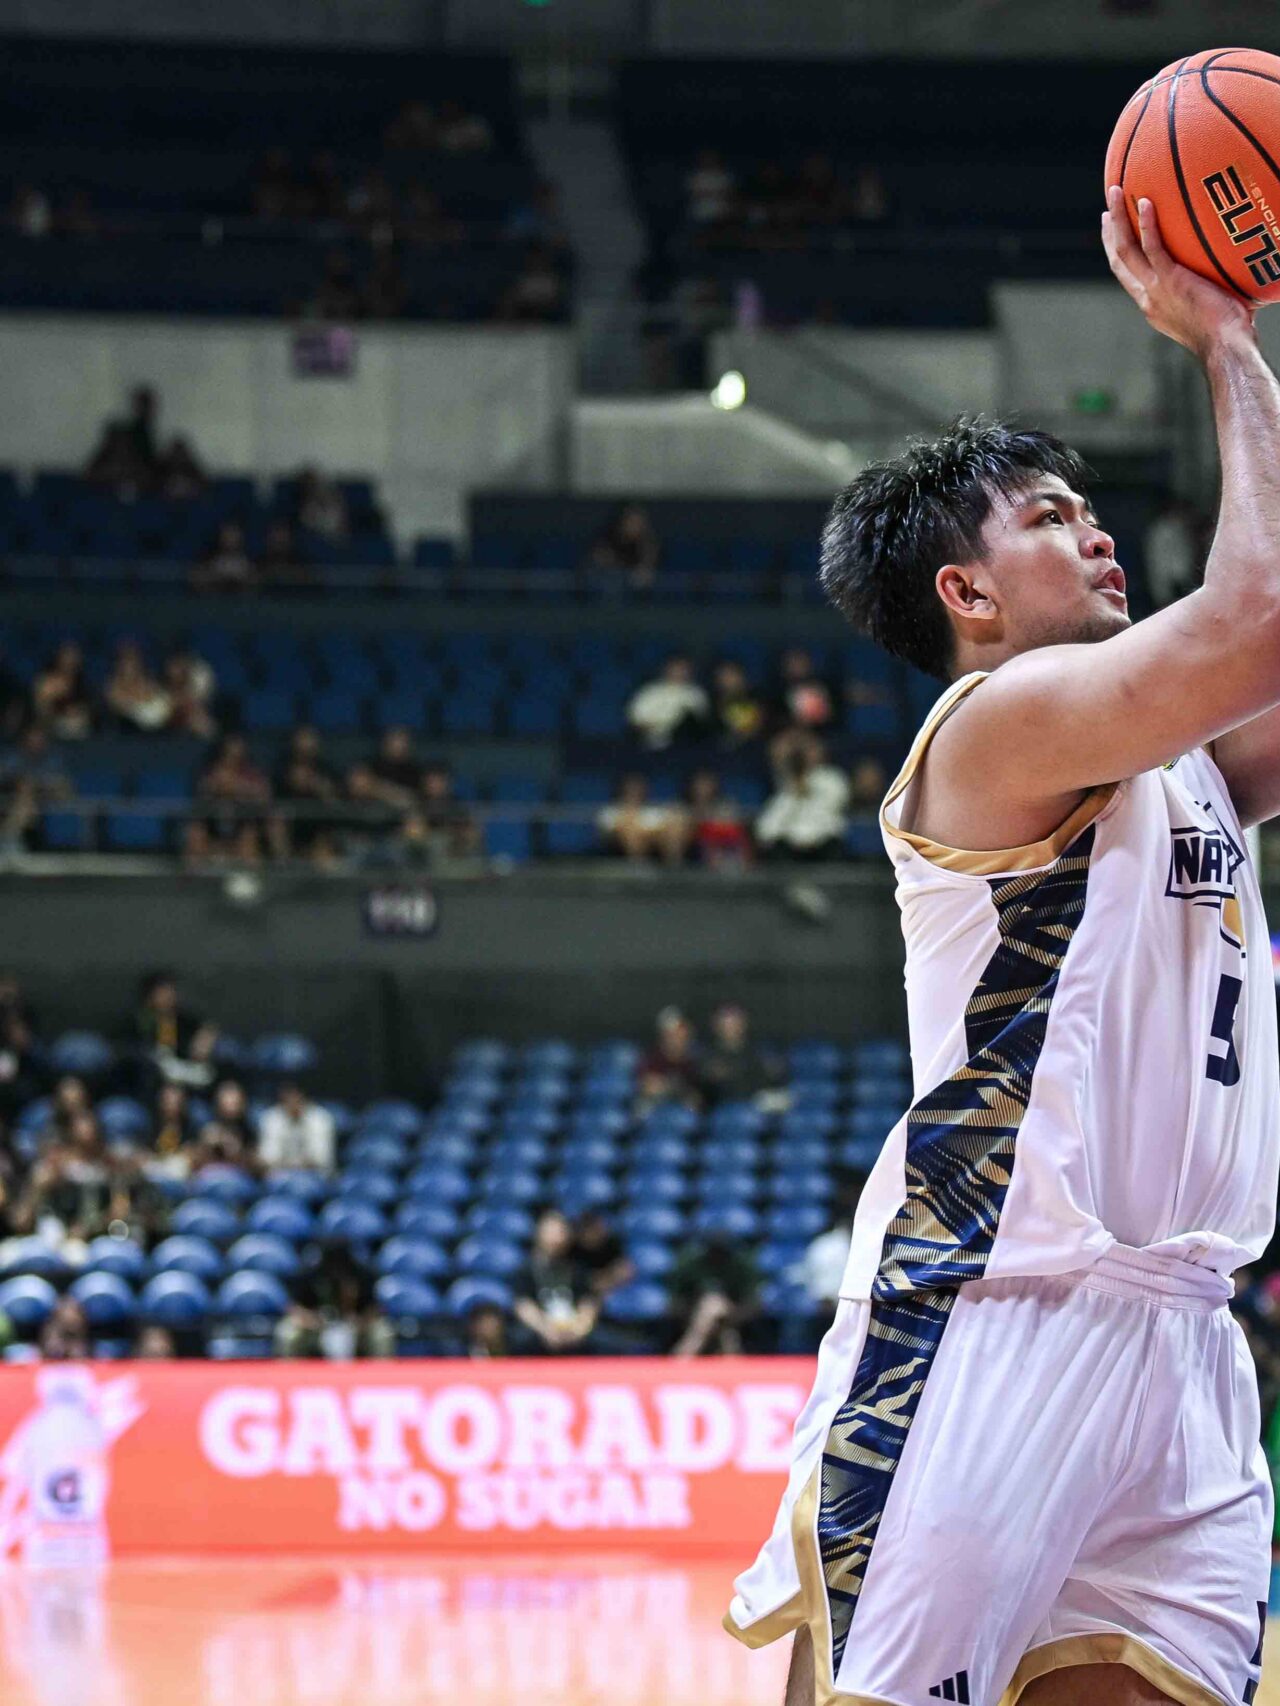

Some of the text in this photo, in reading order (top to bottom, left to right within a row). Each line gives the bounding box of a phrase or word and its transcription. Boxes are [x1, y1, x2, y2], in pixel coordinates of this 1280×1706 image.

[200, 1384, 802, 1477] GATORADE
[338, 1470, 692, 1531] NO SUGAR
